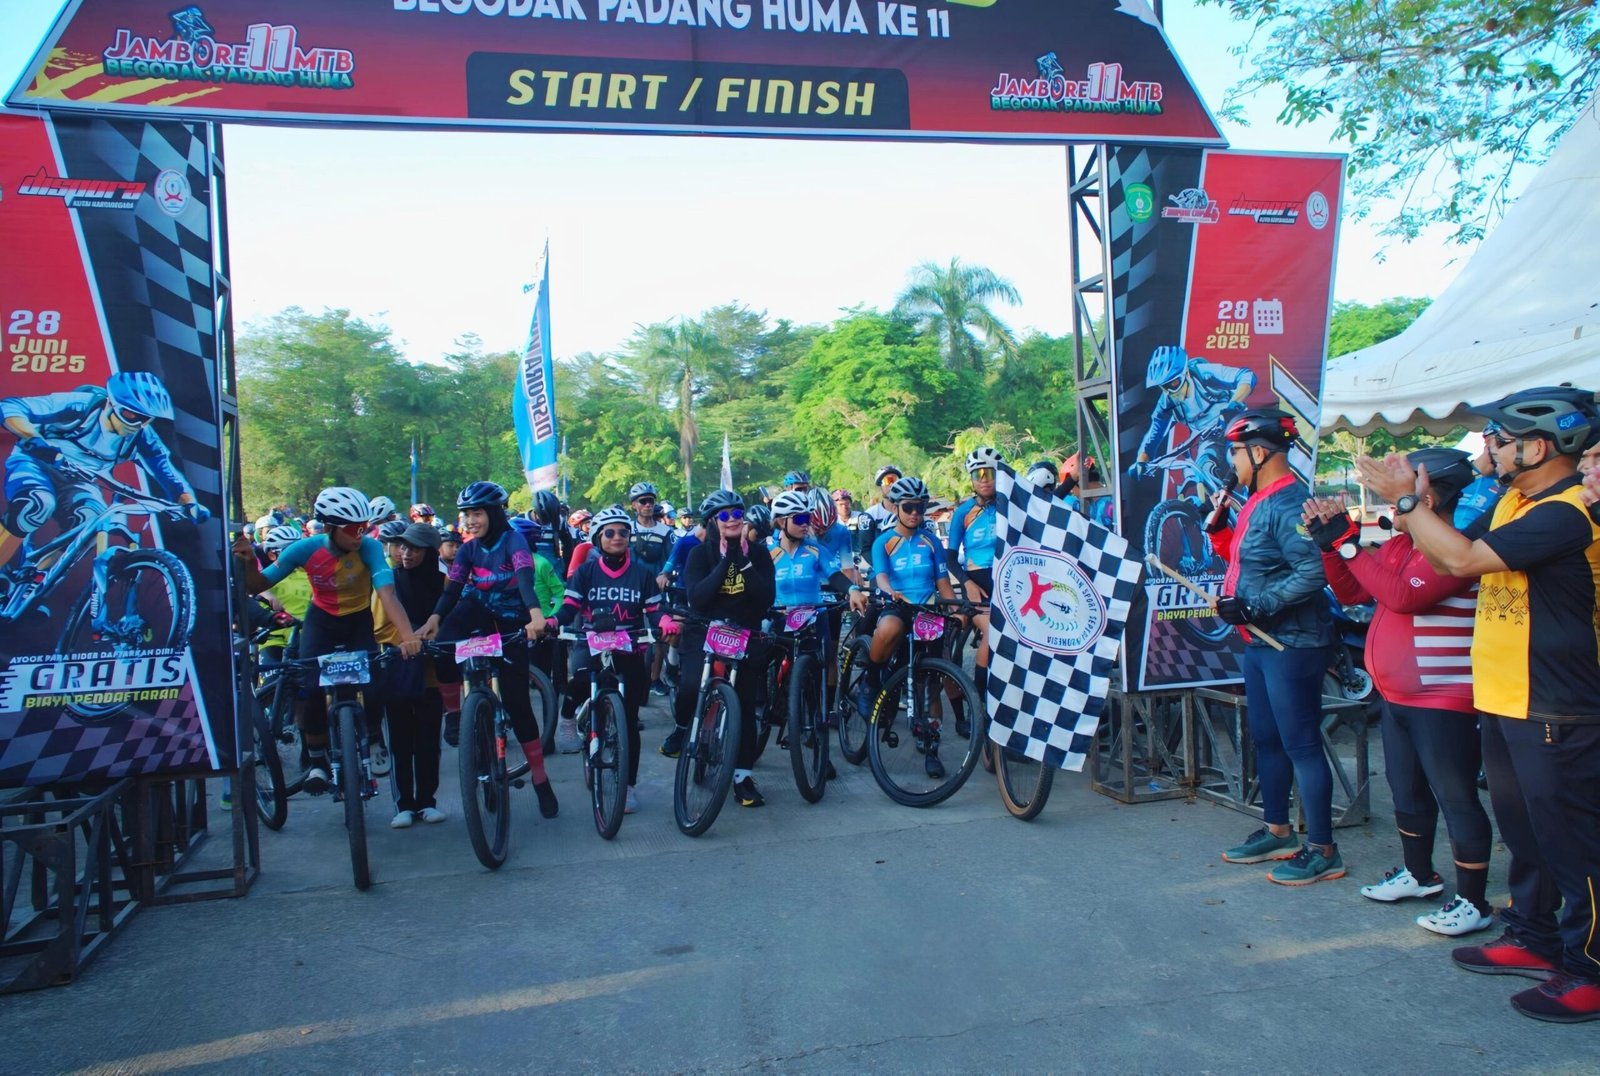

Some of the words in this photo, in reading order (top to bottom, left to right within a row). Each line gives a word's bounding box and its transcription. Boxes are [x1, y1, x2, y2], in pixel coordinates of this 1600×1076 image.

[598, 0, 752, 29] PADANG
[762, 0, 869, 34] HUMA
[877, 1, 918, 36] KE
[927, 8, 950, 38] 11
[104, 30, 248, 69] JAMBORE
[247, 23, 297, 72] 11
[294, 48, 356, 73] MTB
[299, 72, 354, 88] HUMA
[506, 68, 669, 111] START
[678, 77, 704, 113] /
[715, 77, 876, 117] FINISH
[991, 73, 1089, 102] JAMBORE
[1087, 62, 1122, 103] 11
[1119, 81, 1163, 102] MTB
[8, 309, 61, 336] 28
[1218, 300, 1249, 320] 28
[1206, 335, 1250, 350] 2025
[11, 355, 87, 373] 2025
[30, 657, 182, 690] GRATIS
[25, 694, 71, 708] BIAYA
[74, 688, 179, 705] PENDAFTARAN
